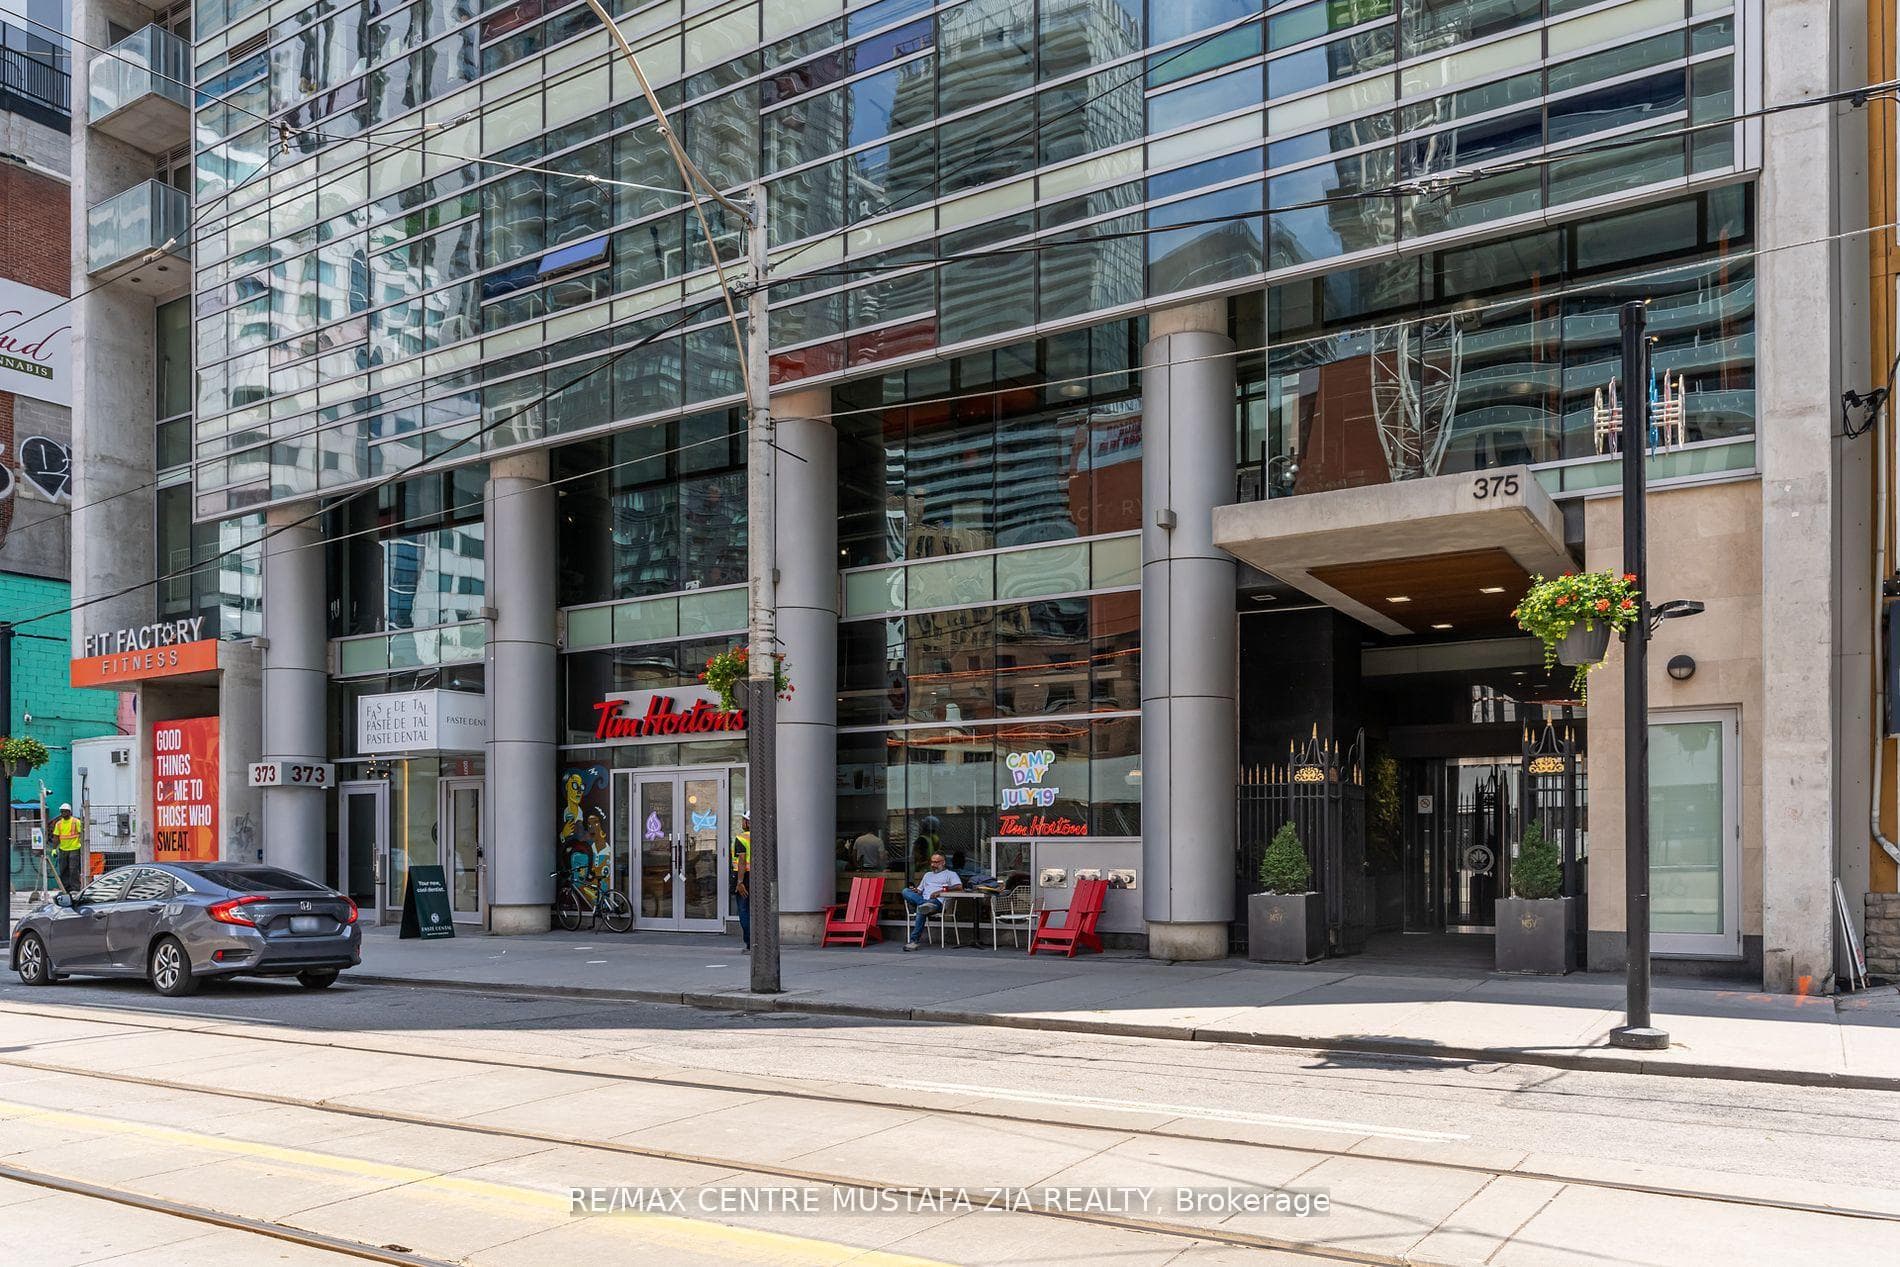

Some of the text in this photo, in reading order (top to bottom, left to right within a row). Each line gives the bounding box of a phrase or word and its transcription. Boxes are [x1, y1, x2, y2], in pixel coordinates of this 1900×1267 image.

[0, 310, 72, 361] ud
[1473, 474, 1519, 499] 375
[85, 616, 204, 659] FIT FACTORY
[102, 650, 178, 675] FITNESS
[366, 718, 391, 731] PASTE
[593, 694, 745, 739] Tim Hortons
[156, 729, 181, 751] GOOD
[366, 730, 428, 745] PASTE DENTAL
[157, 753, 191, 776] THINGS
[1006, 750, 1055, 770] CAMP
[255, 765, 276, 783] 373
[291, 765, 326, 783] 373
[1013, 767, 1044, 785] DAY
[157, 778, 203, 801] CME TO
[1002, 788, 1034, 810] JULY
[157, 804, 211, 827] THOSE WHO
[1000, 815, 1088, 836] Tim Hortons
[157, 831, 190, 852] SWEAT.
